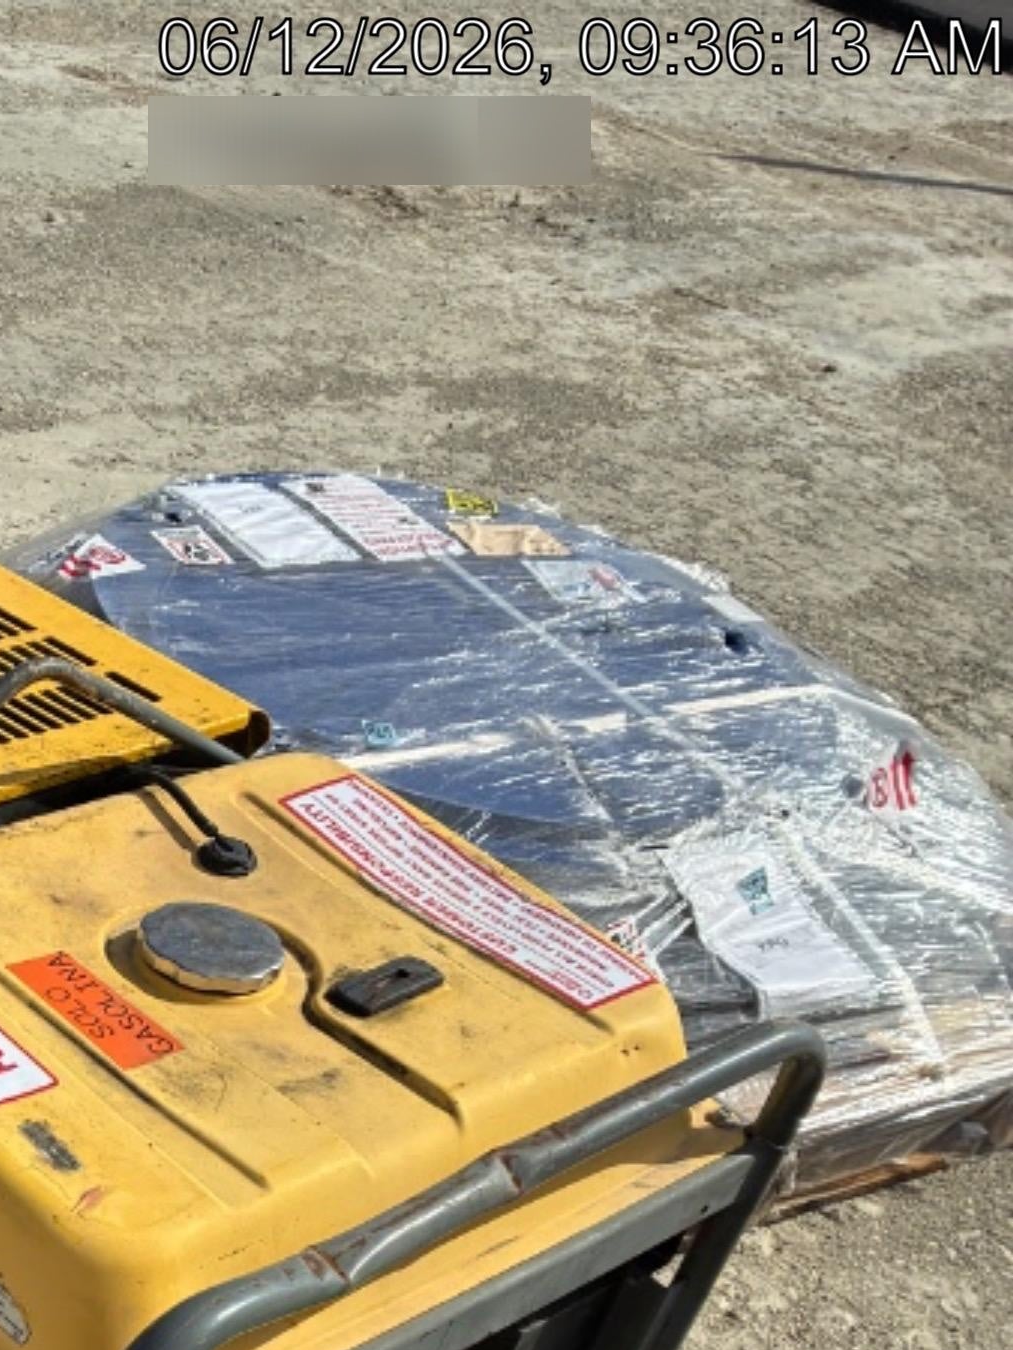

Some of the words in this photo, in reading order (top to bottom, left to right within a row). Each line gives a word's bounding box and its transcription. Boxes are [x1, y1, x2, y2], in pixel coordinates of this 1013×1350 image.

[299, 802, 428, 898] RESPONSIBILITY
[419, 896, 519, 955] CUSTOMER
[44, 984, 115, 1042] SOLO
[46, 950, 174, 1056] GASOLINA
